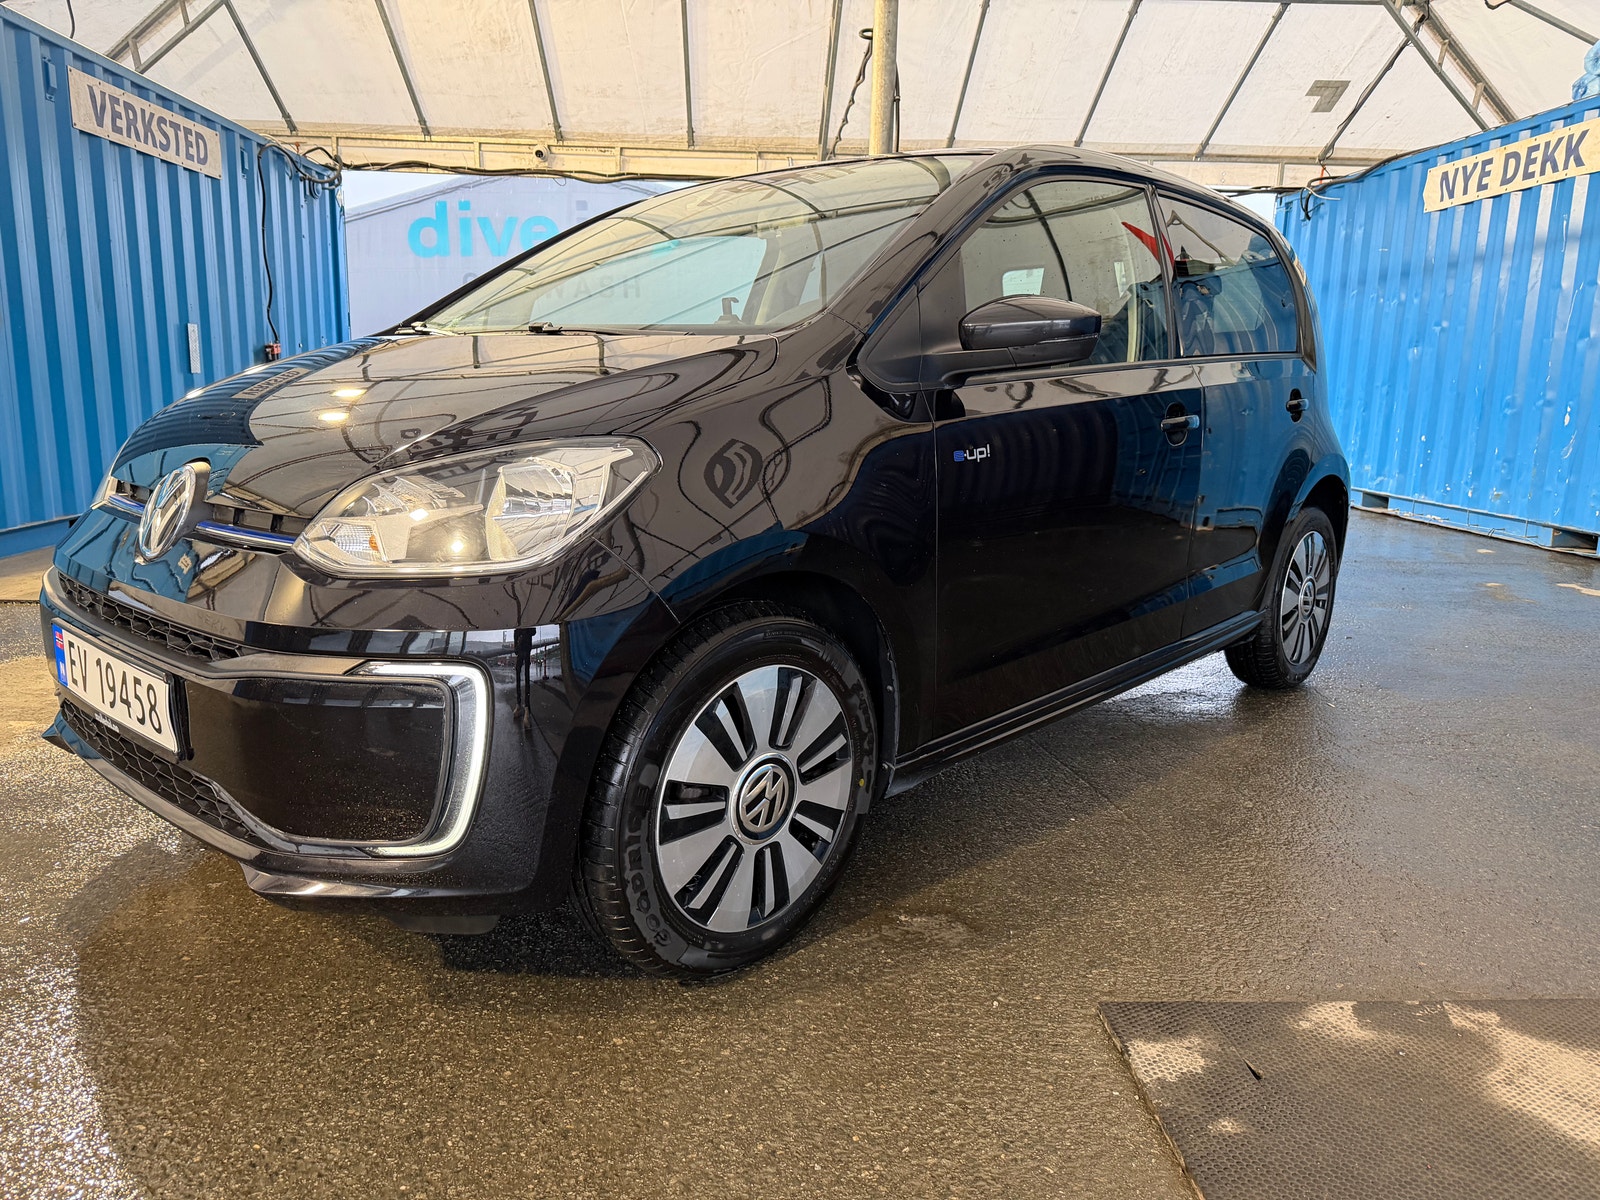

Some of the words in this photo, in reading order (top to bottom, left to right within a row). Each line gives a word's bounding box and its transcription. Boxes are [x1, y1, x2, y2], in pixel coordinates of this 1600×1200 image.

[87, 84, 208, 166] VERKSTED
[1439, 157, 1494, 203] NYE
[1500, 128, 1590, 187] DEKK
[407, 200, 560, 258] dive
[67, 639, 88, 694] EV
[95, 657, 162, 735] 19458
